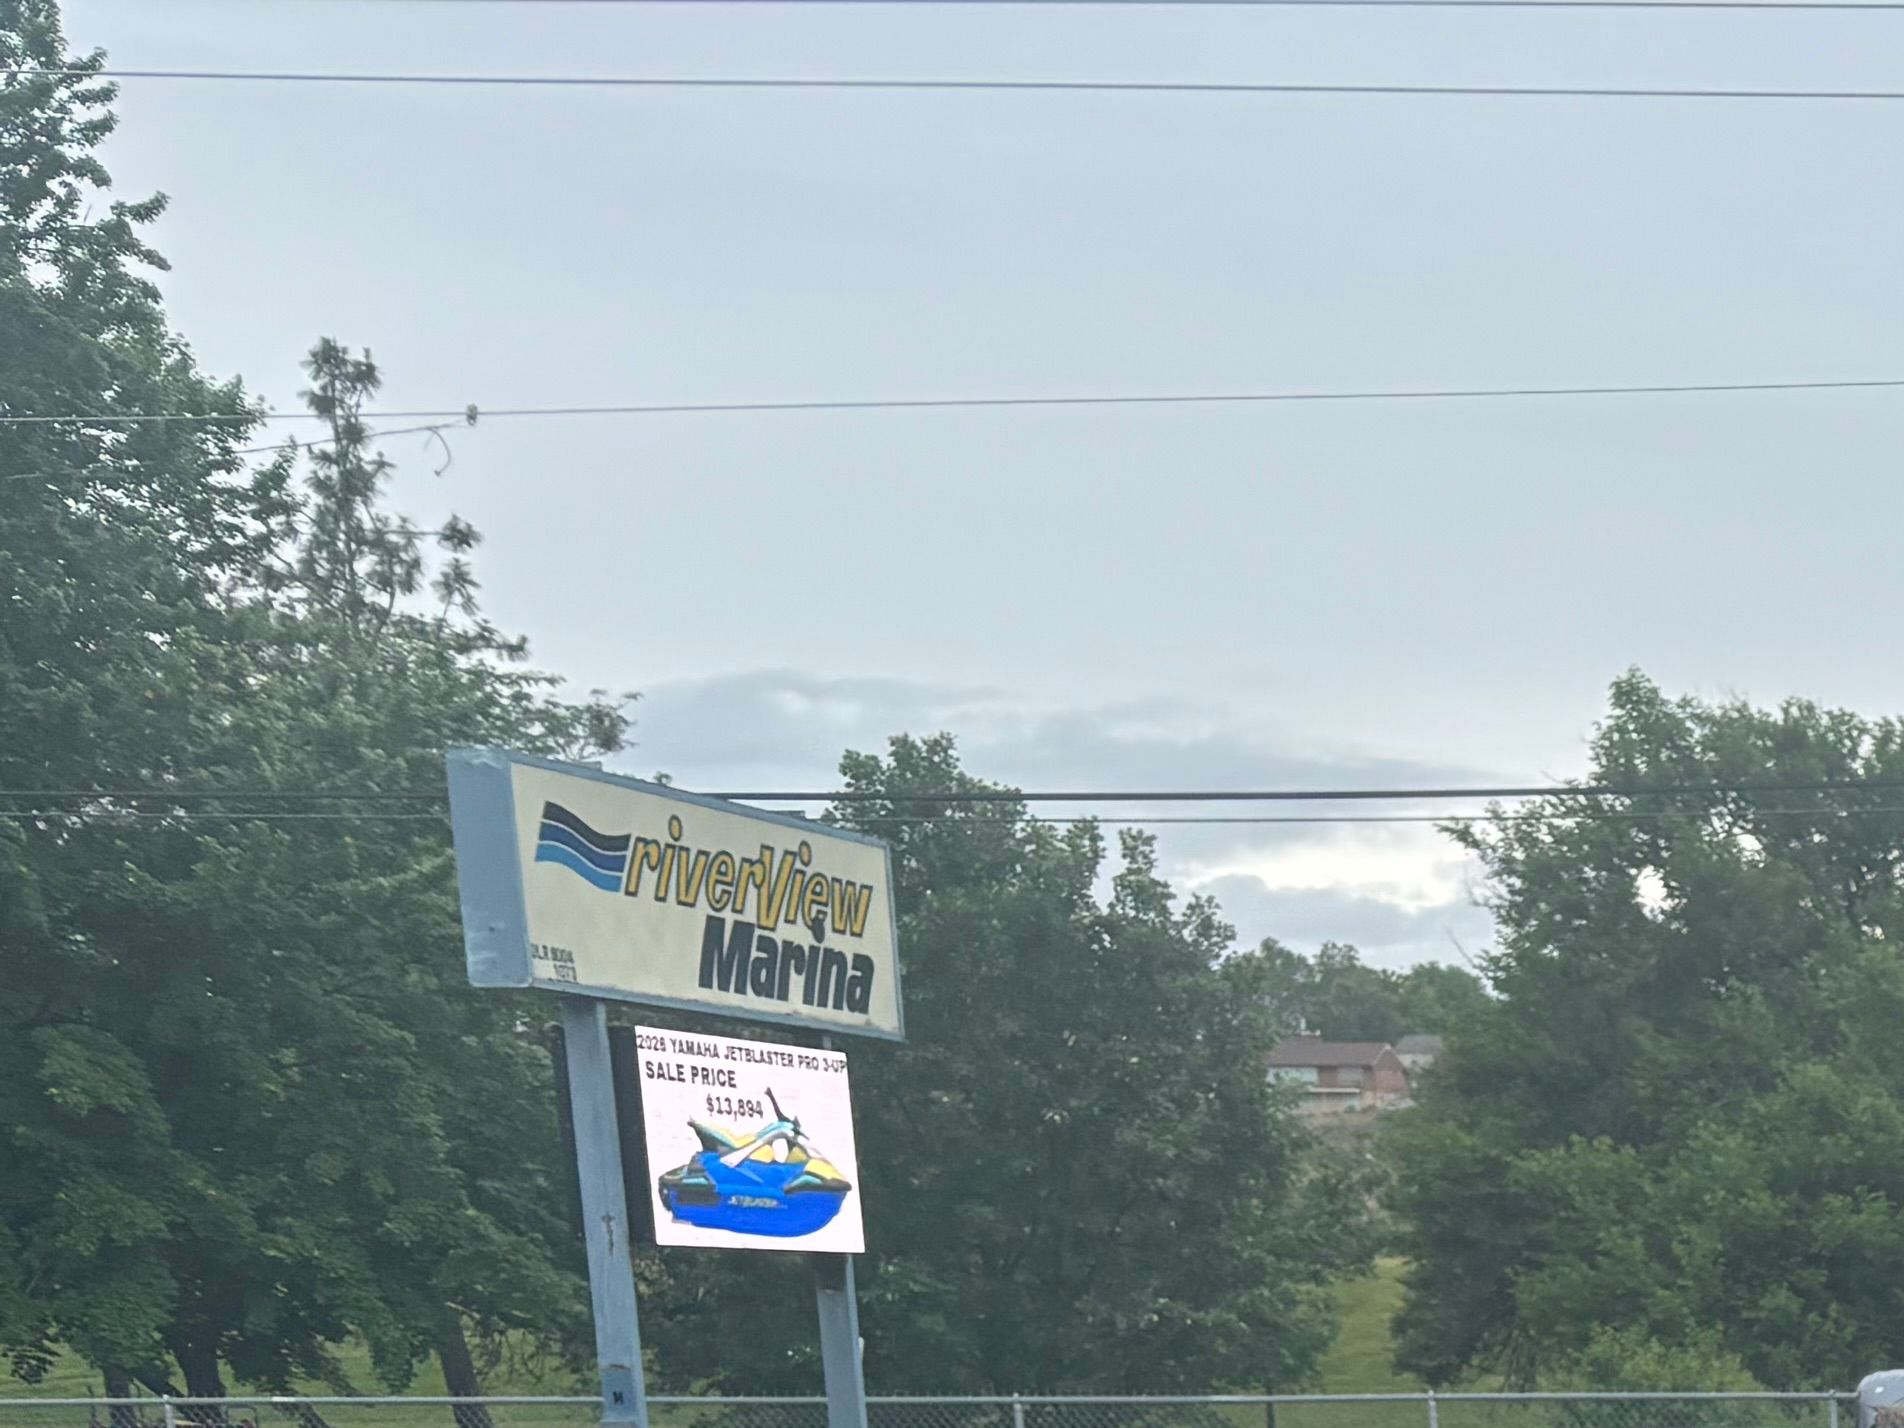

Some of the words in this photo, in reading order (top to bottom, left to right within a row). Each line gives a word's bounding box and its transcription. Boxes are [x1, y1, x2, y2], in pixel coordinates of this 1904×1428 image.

[699, 914, 876, 1015] Marina
[670, 1037, 720, 1059] YAMAHA
[724, 1045, 795, 1068] JETBLASTER
[798, 1054, 819, 1071] PRO
[645, 1060, 686, 1083] SALE
[690, 1065, 737, 1089] PRICE
